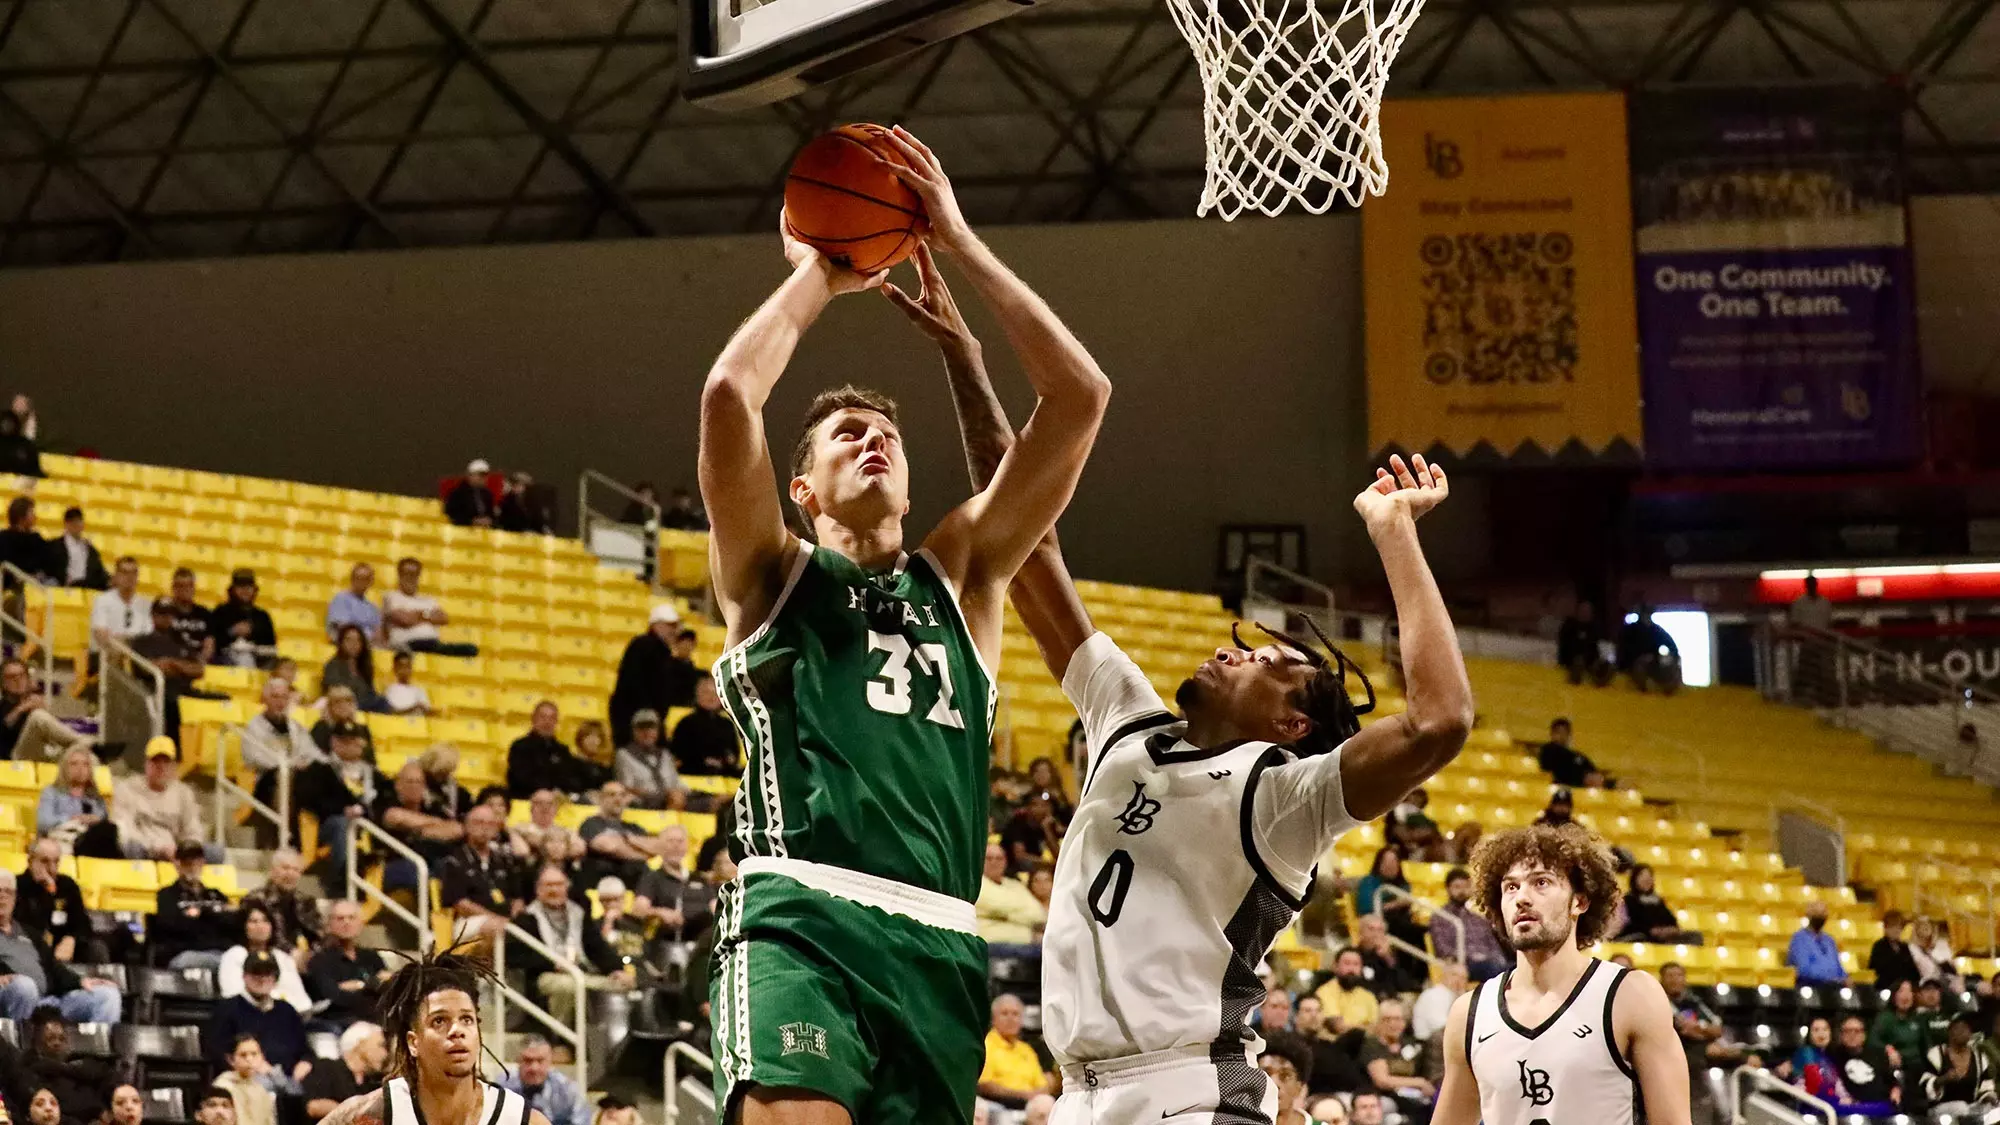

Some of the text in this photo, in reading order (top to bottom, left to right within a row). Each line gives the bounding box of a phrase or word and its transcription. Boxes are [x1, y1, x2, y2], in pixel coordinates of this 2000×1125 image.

[1653, 260, 1892, 293] One Community.
[1698, 290, 1850, 318] One Team.
[865, 630, 966, 731] 32
[1113, 779, 1162, 836] LB
[1087, 848, 1135, 929] 0
[1082, 1063, 1099, 1088] LB
[1516, 1059, 1555, 1108] LB
